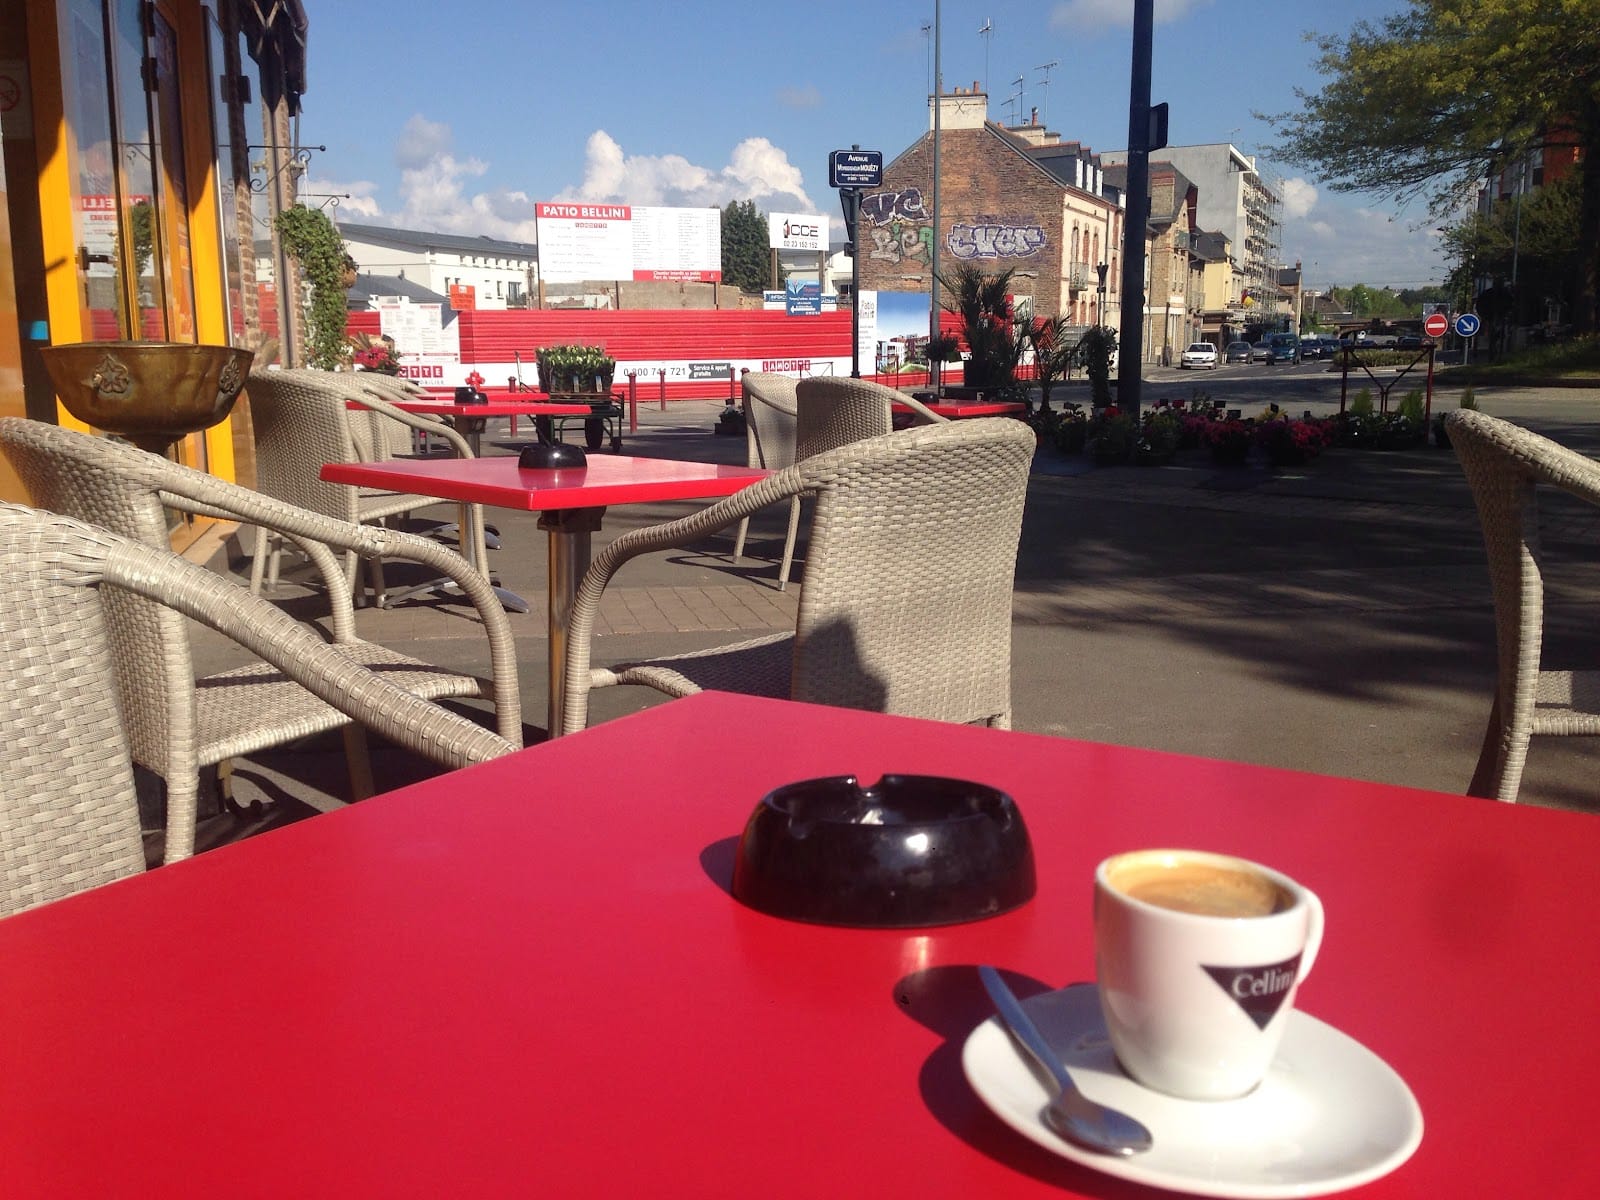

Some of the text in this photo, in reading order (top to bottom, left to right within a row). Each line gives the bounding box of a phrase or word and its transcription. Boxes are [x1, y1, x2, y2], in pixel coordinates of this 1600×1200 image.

[543, 205, 625, 218] PATIO BELLINI
[670, 367, 686, 376] 721
